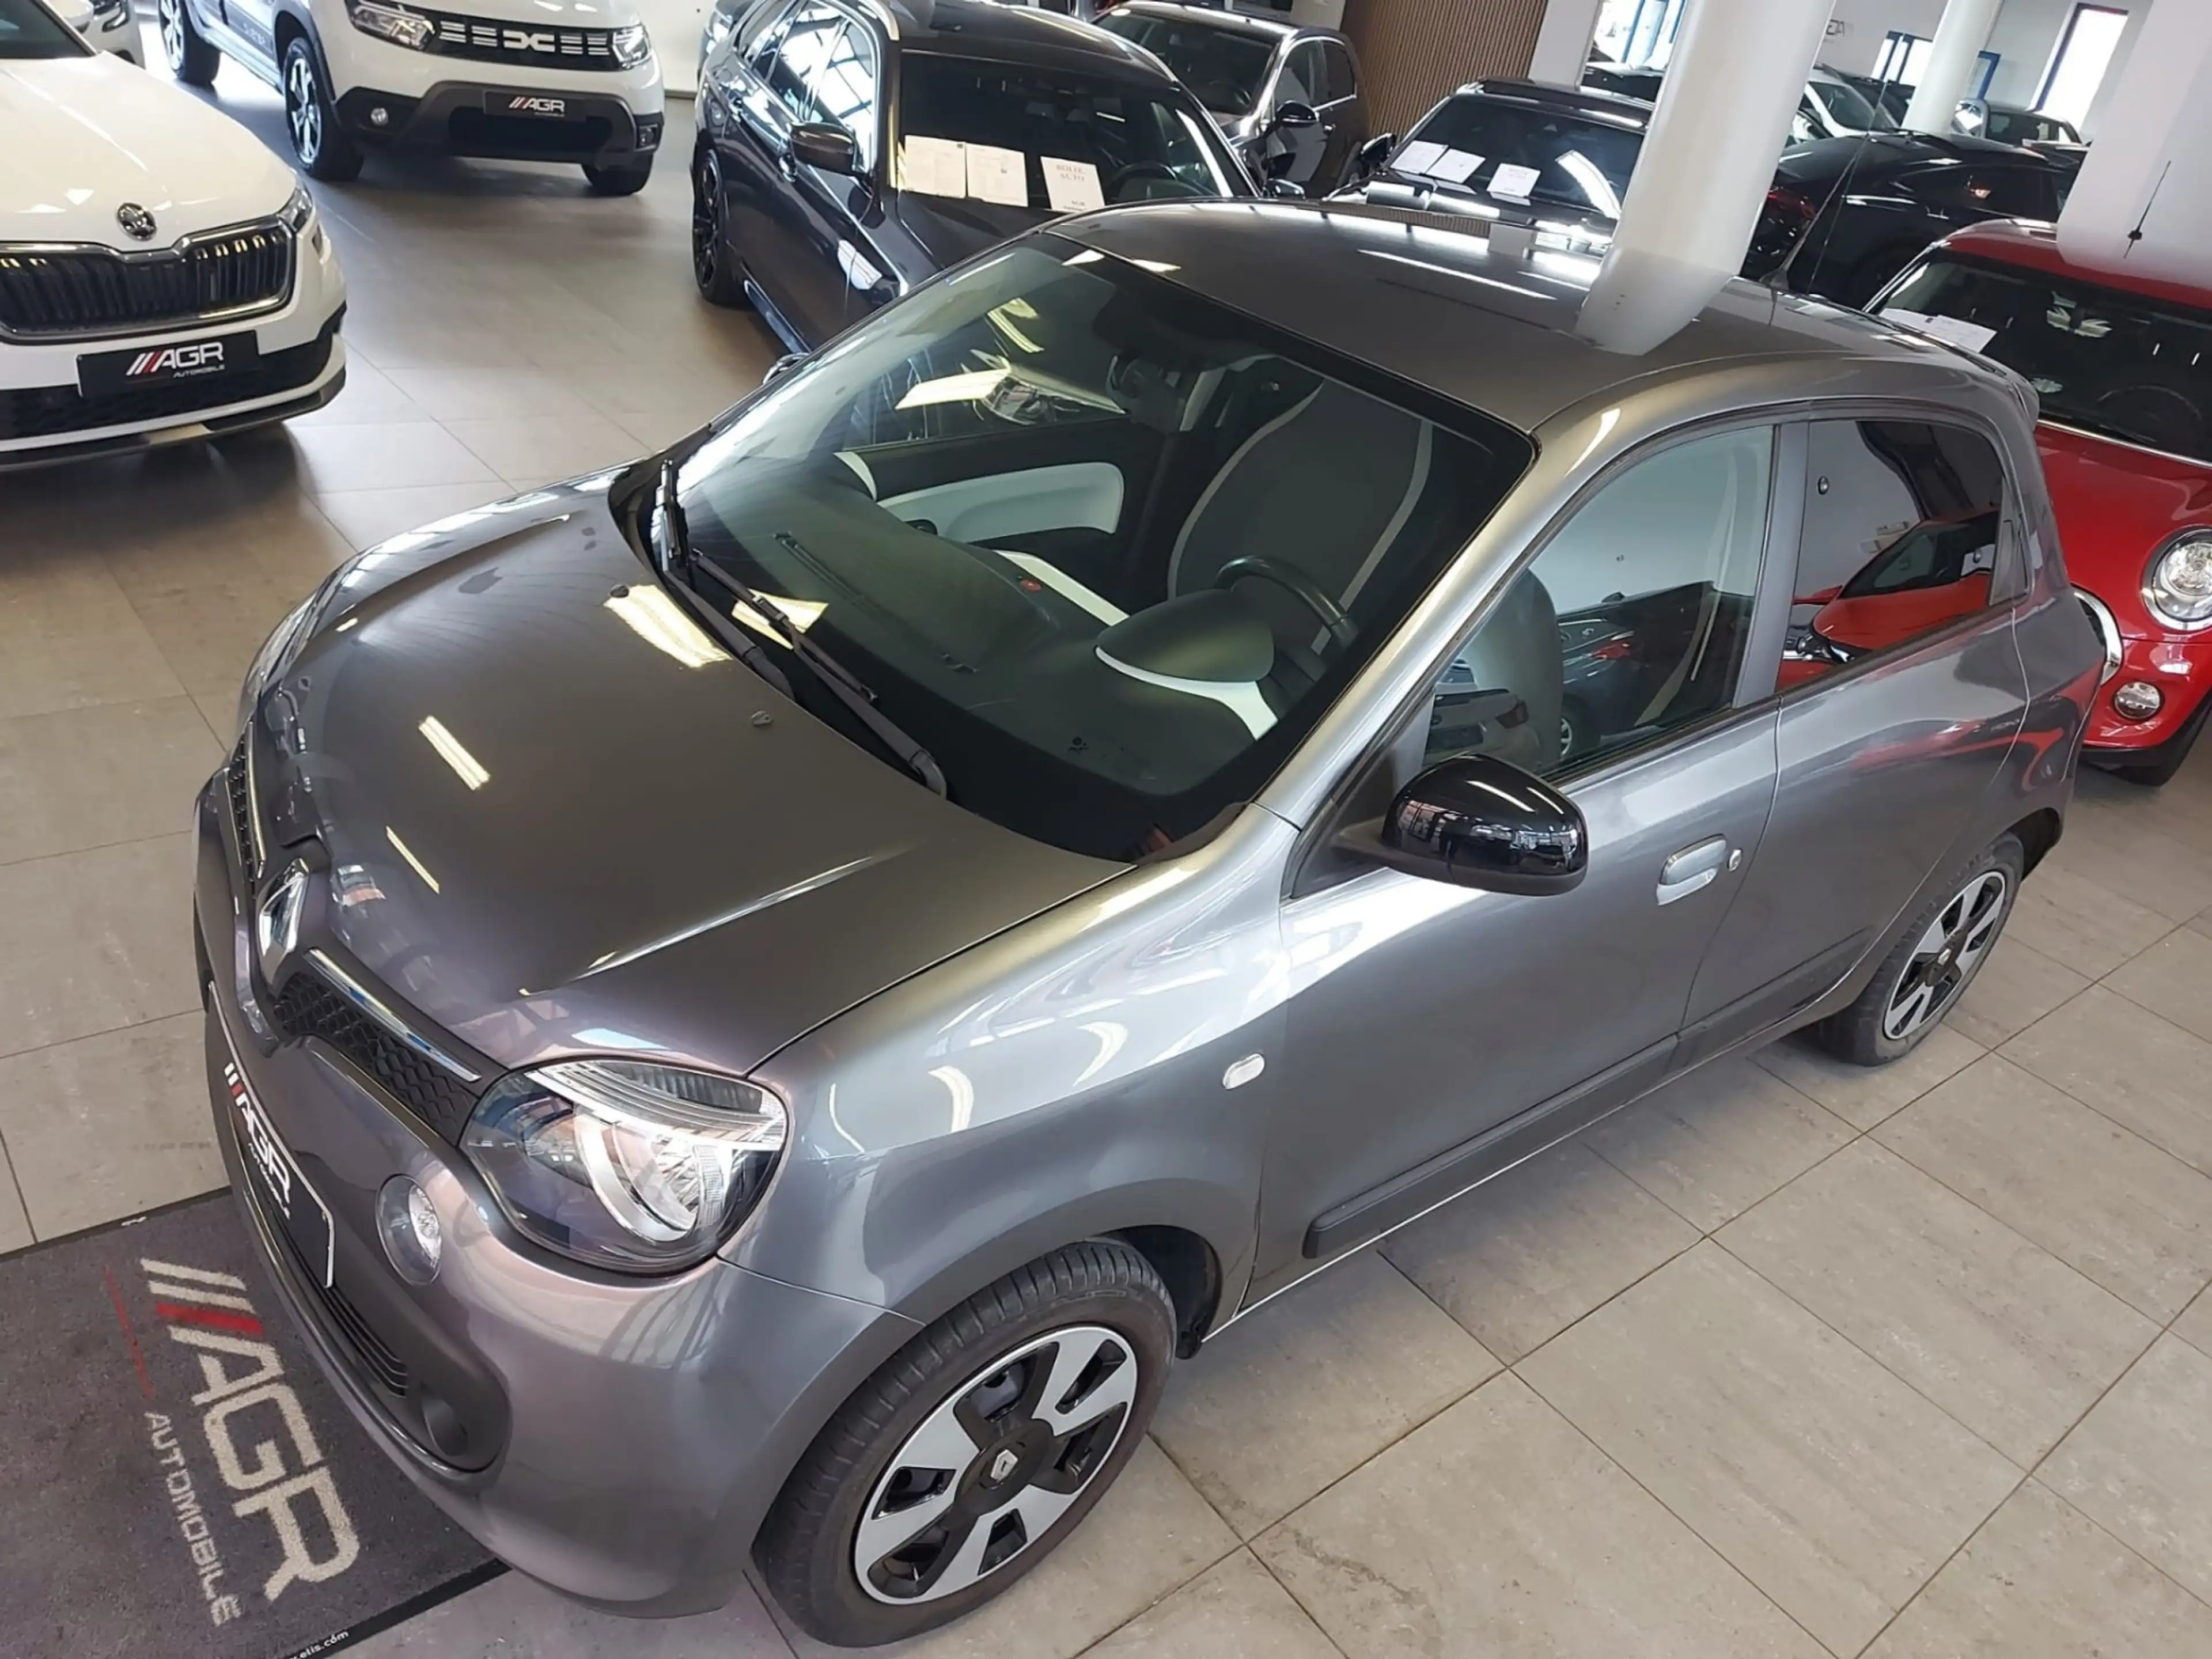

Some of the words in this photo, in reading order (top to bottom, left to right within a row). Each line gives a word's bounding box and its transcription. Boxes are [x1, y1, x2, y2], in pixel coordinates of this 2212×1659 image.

[522, 97, 565, 112] AGR
[151, 342, 224, 372] AGR
[235, 1093, 290, 1204] AGR
[168, 1324, 359, 1601] AGR
[145, 1411, 242, 1627] AUTOMOBILE
